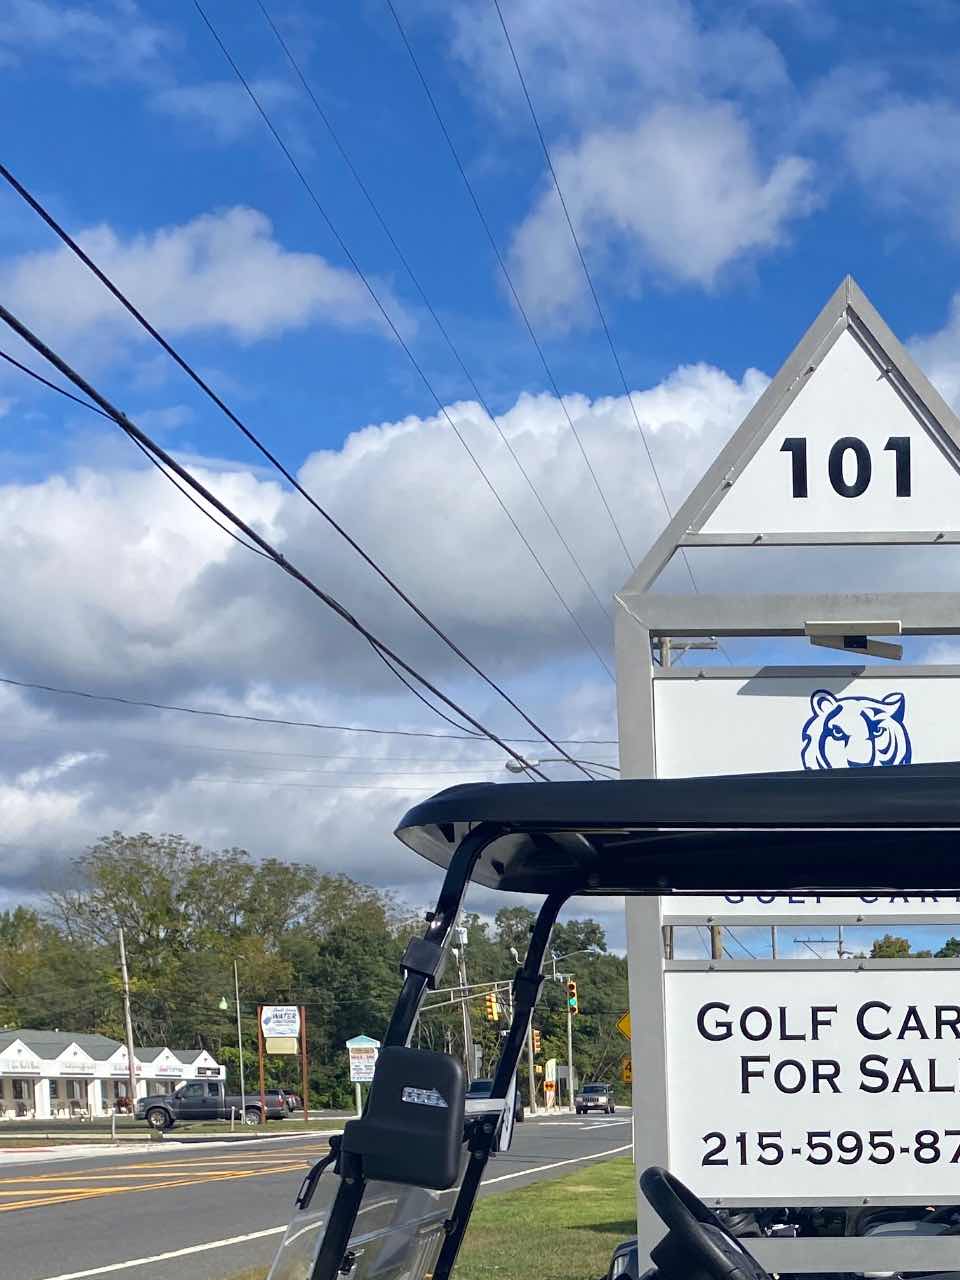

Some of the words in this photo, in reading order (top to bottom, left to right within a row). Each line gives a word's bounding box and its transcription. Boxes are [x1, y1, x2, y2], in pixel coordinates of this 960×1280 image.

[779, 436, 911, 499] 101
[696, 1001, 838, 1042] GOLF
[740, 1054, 841, 1095] FOR
